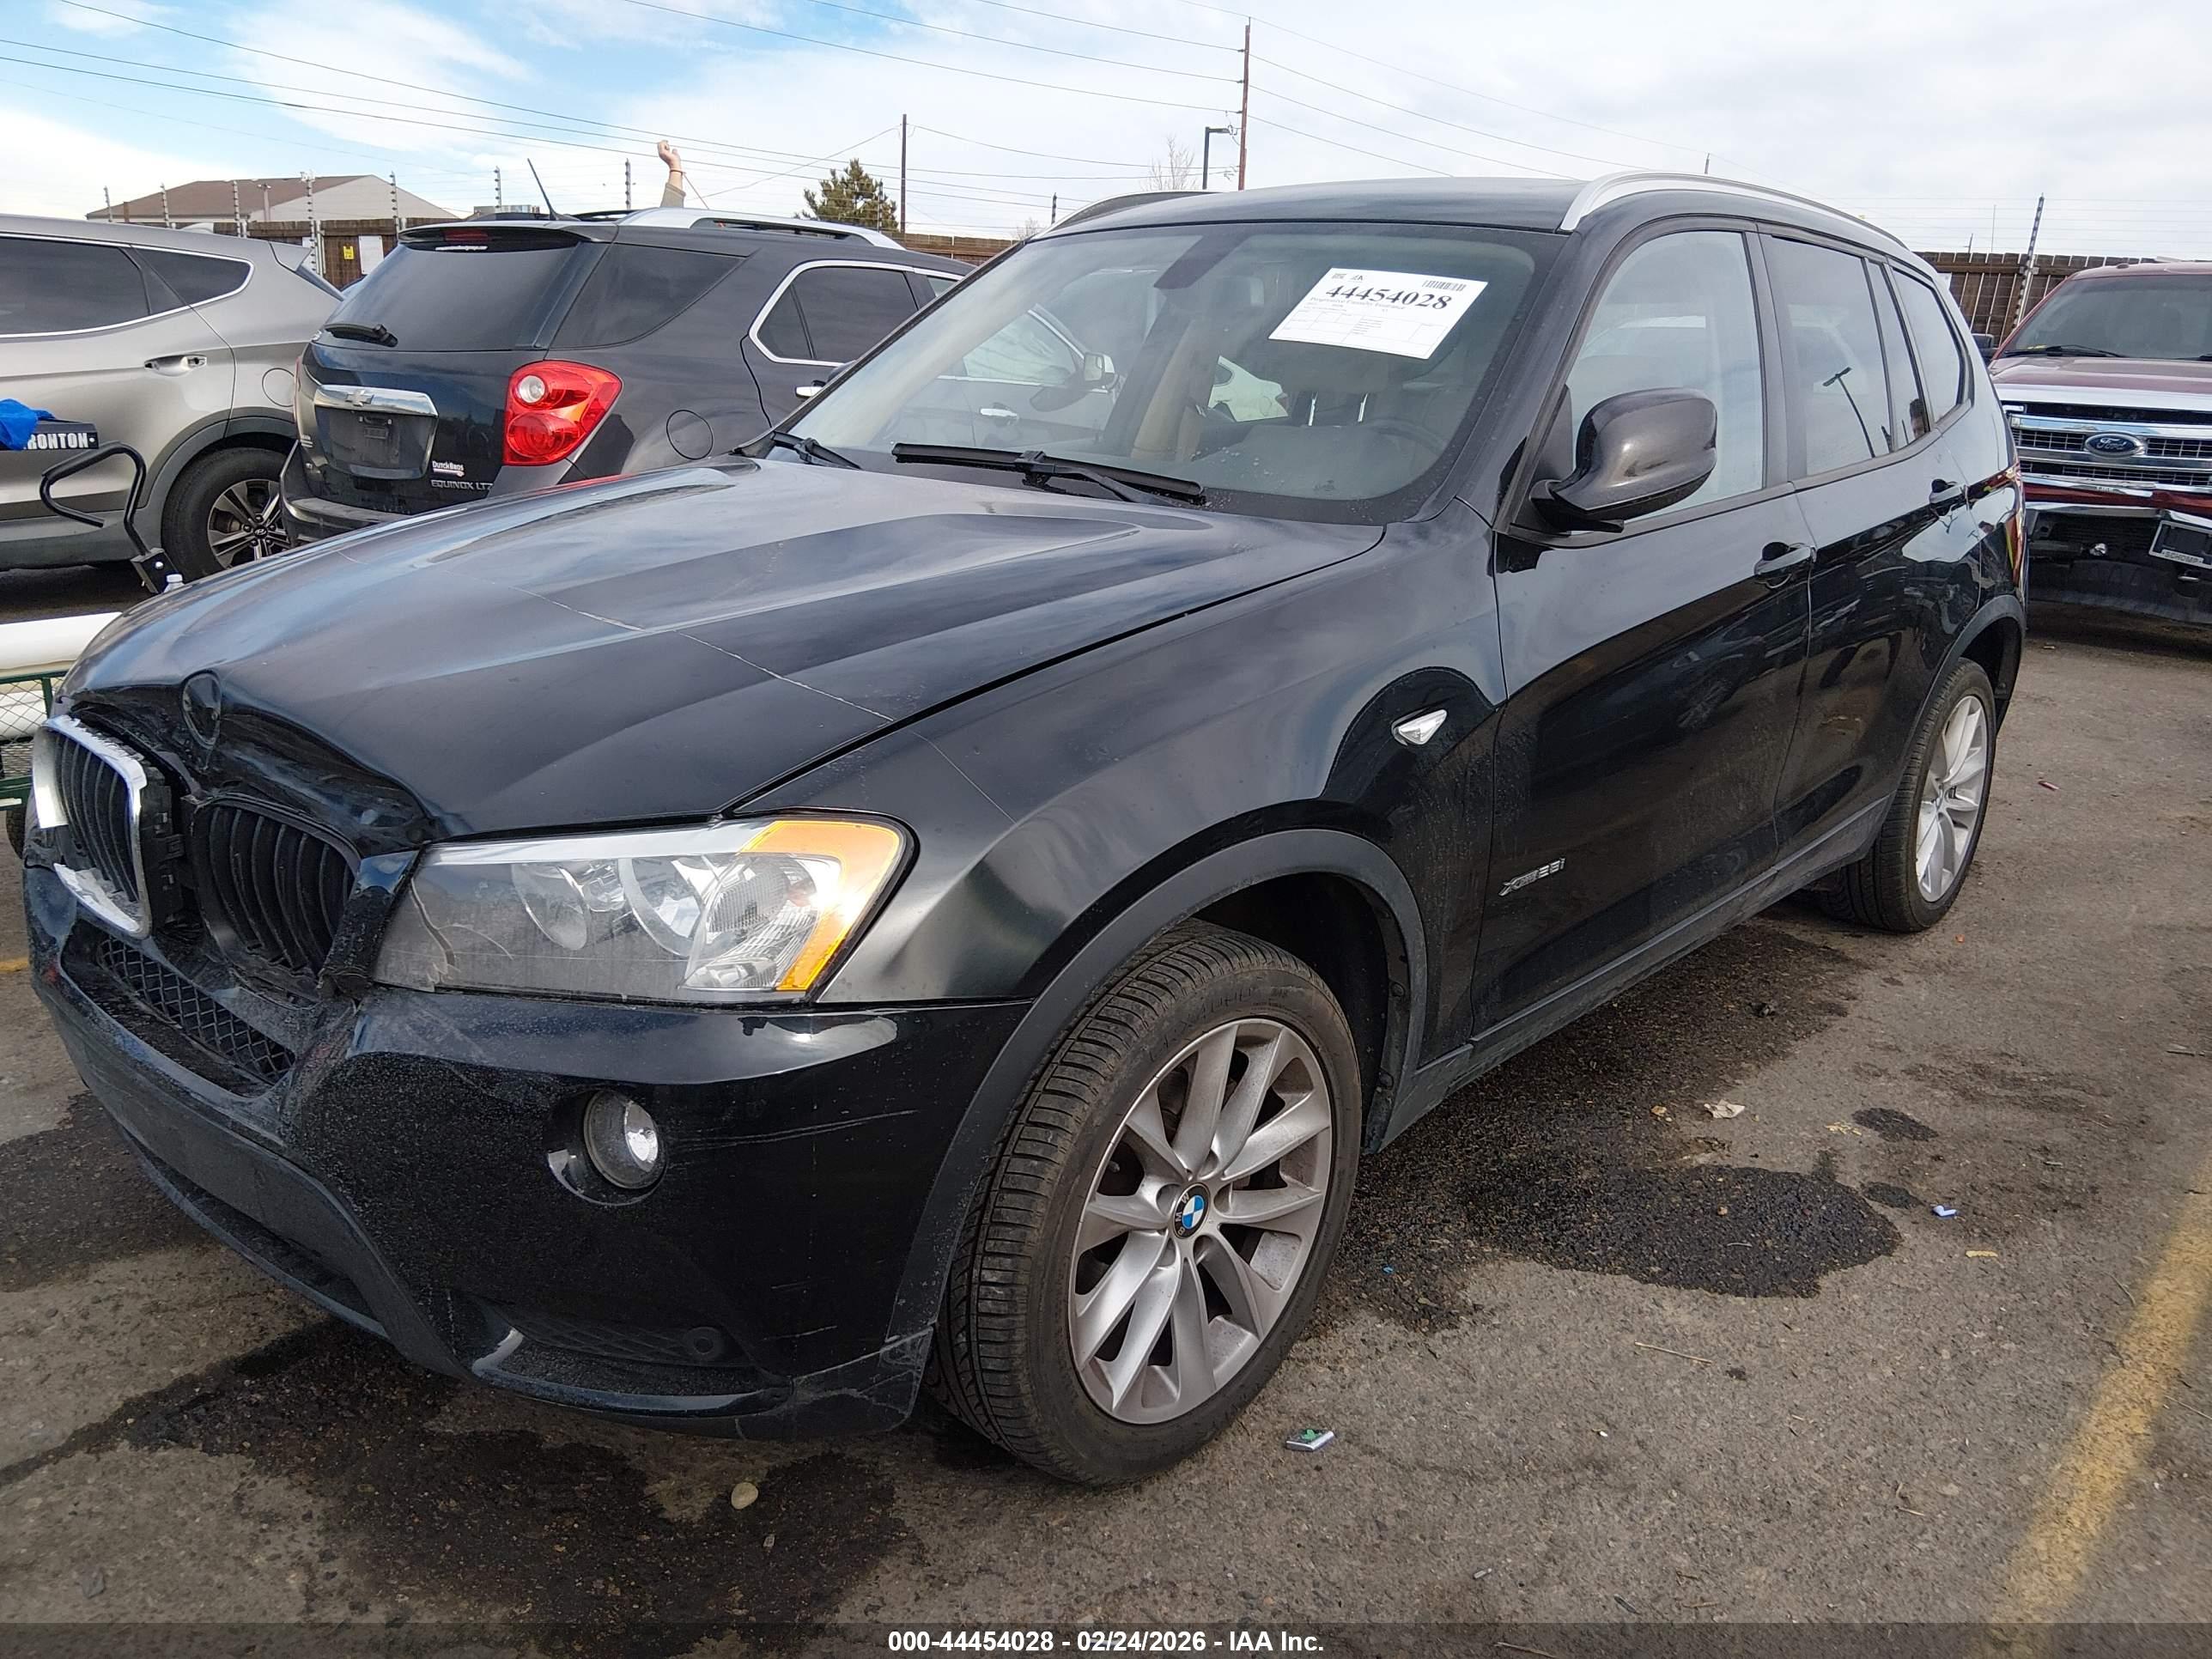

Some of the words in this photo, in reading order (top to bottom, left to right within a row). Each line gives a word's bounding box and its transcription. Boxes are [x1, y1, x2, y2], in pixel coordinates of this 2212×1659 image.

[1325, 284, 1453, 310] 44454028
[24, 432, 89, 450] RONTON
[2096, 437, 2128, 451] Ford
[430, 479, 474, 490] EQUINOX
